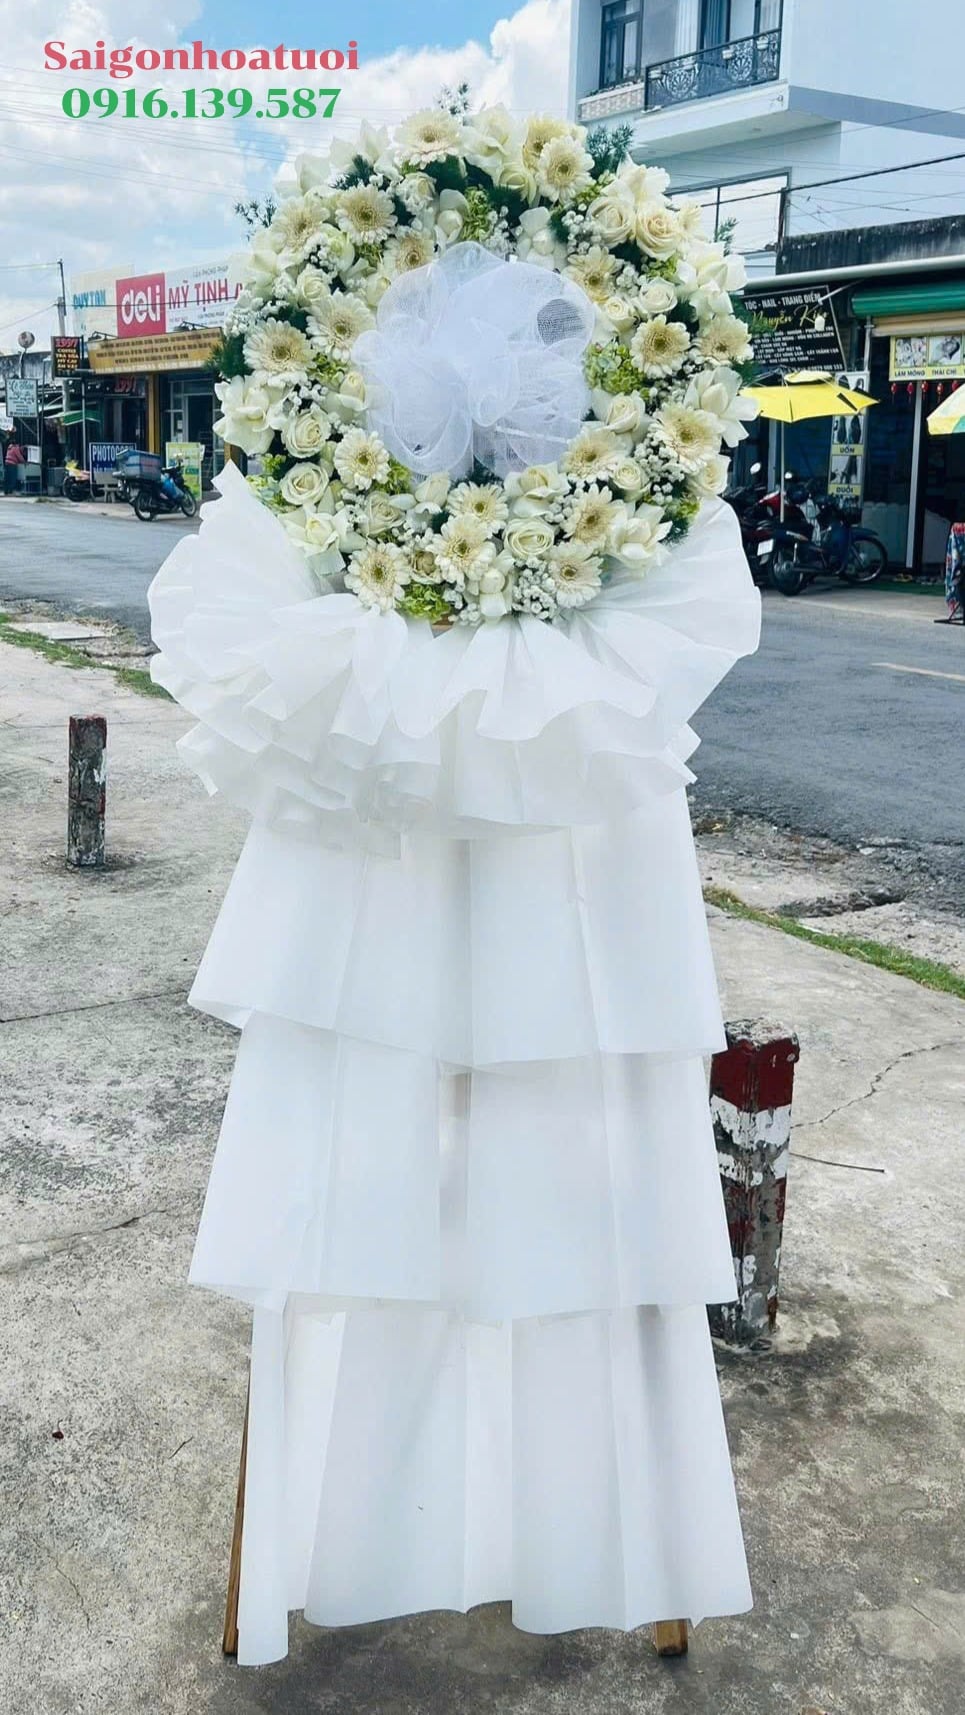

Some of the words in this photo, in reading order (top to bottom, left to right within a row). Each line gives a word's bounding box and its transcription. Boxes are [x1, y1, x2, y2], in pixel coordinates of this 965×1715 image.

[121, 284, 161, 325] deli
[168, 279, 189, 310] MỸ
[194, 278, 229, 312] TỊNH
[761, 298, 777, 308] NAIL
[781, 295, 804, 306] TRANG
